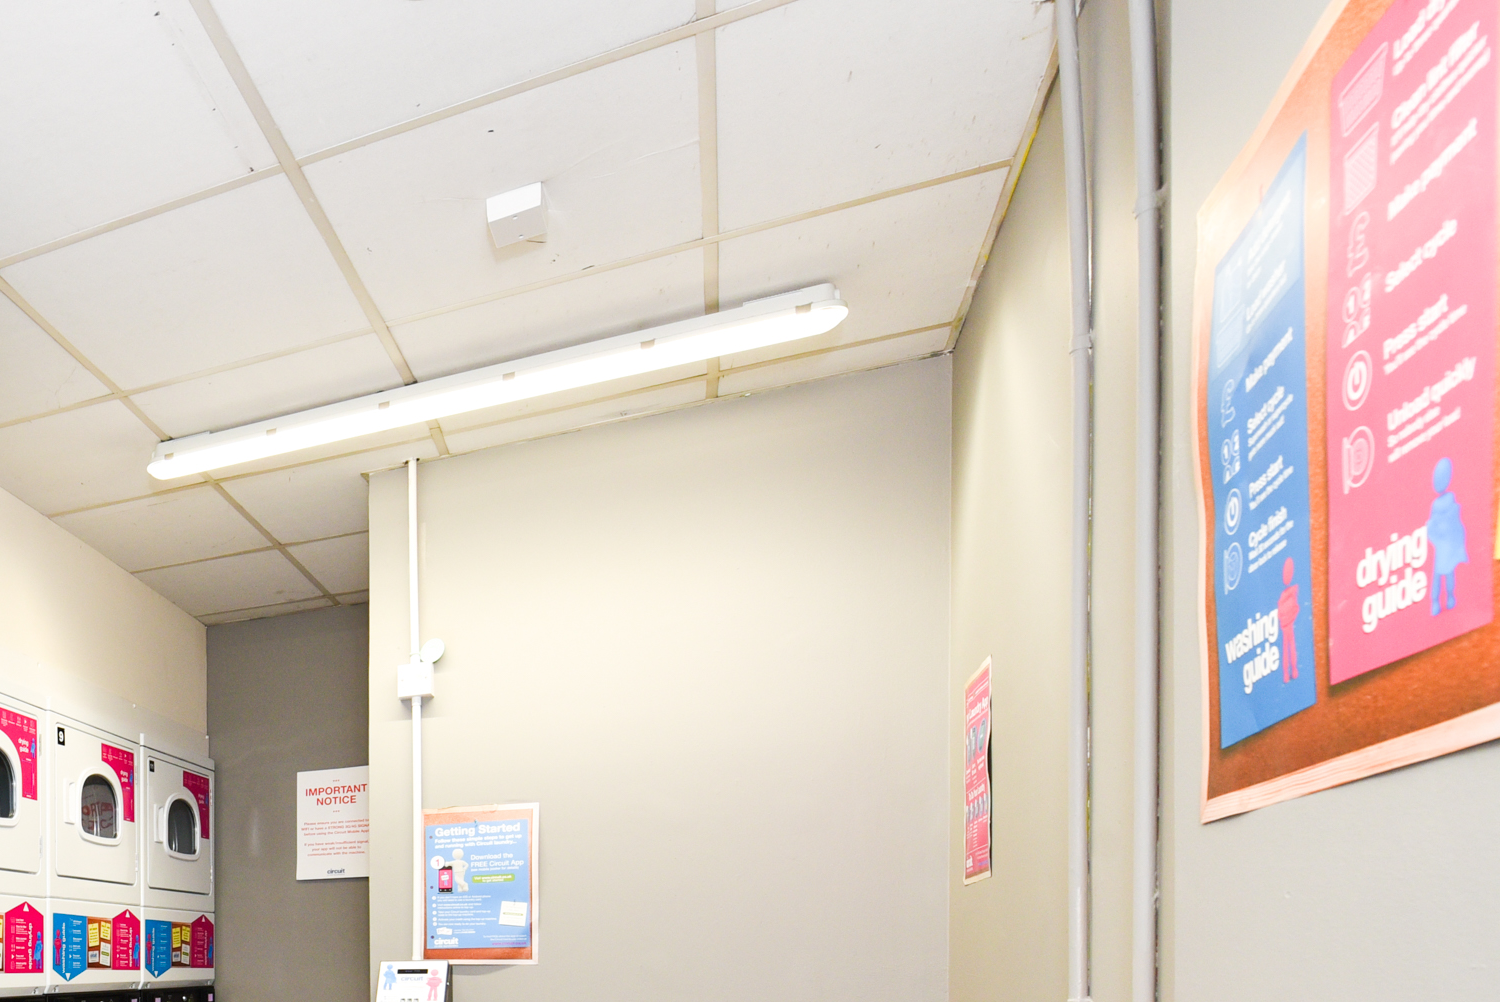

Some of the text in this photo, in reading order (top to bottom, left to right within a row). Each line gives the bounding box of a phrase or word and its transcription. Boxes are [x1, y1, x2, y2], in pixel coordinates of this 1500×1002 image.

[1356, 526, 1428, 588] drying
[1362, 568, 1428, 633] guide
[1225, 608, 1279, 664] washing
[1242, 646, 1280, 694] guide
[59, 731, 64, 742] 9
[305, 783, 368, 797] IMPORTANT
[316, 795, 357, 806] NOTICE
[435, 822, 520, 837] Getting Started
[434, 937, 459, 945] circuit
